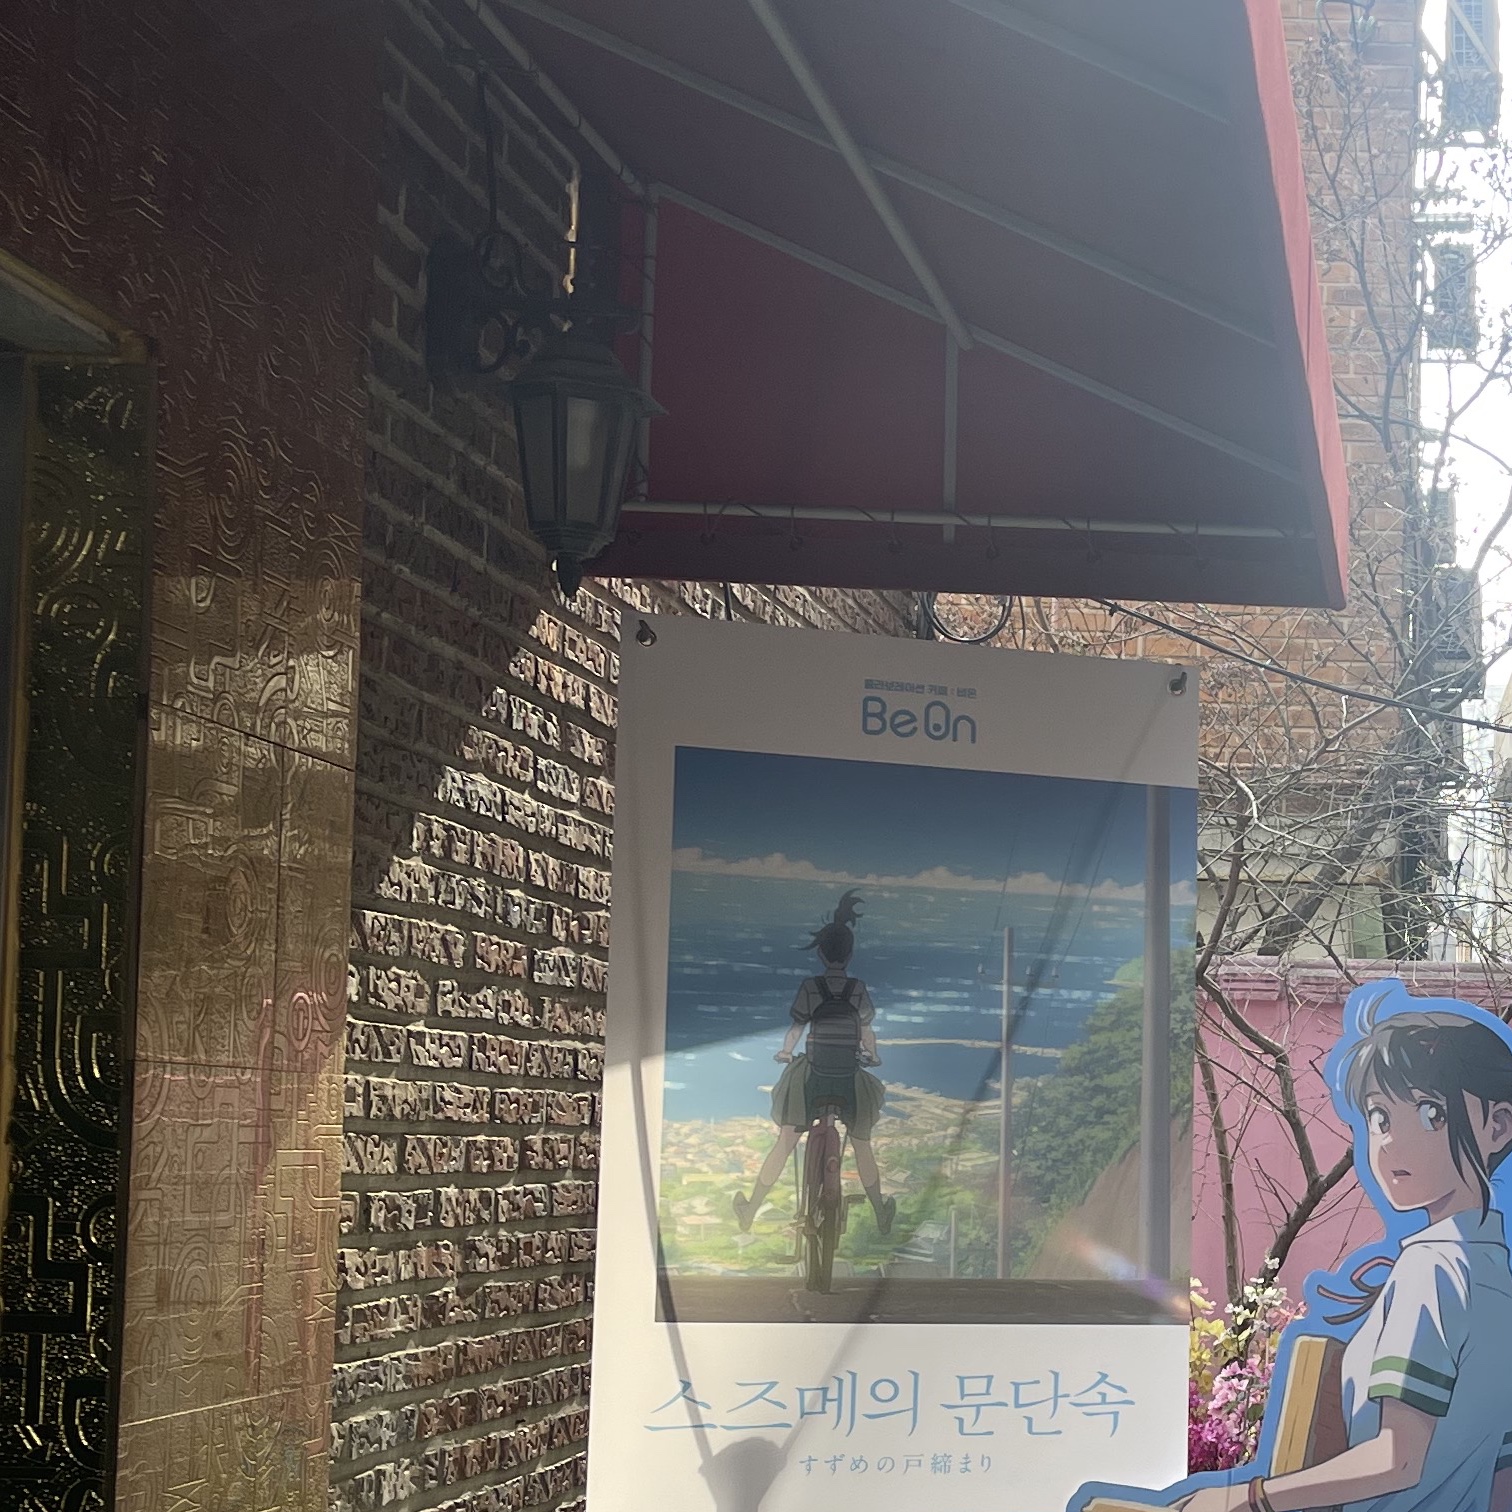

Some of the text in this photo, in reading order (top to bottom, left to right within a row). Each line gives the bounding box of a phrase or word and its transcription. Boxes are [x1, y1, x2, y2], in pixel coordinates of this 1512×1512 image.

[643, 1369, 1136, 1438] 스즈메의 문단속
[799, 1452, 993, 1476] すずめの戸締まり
